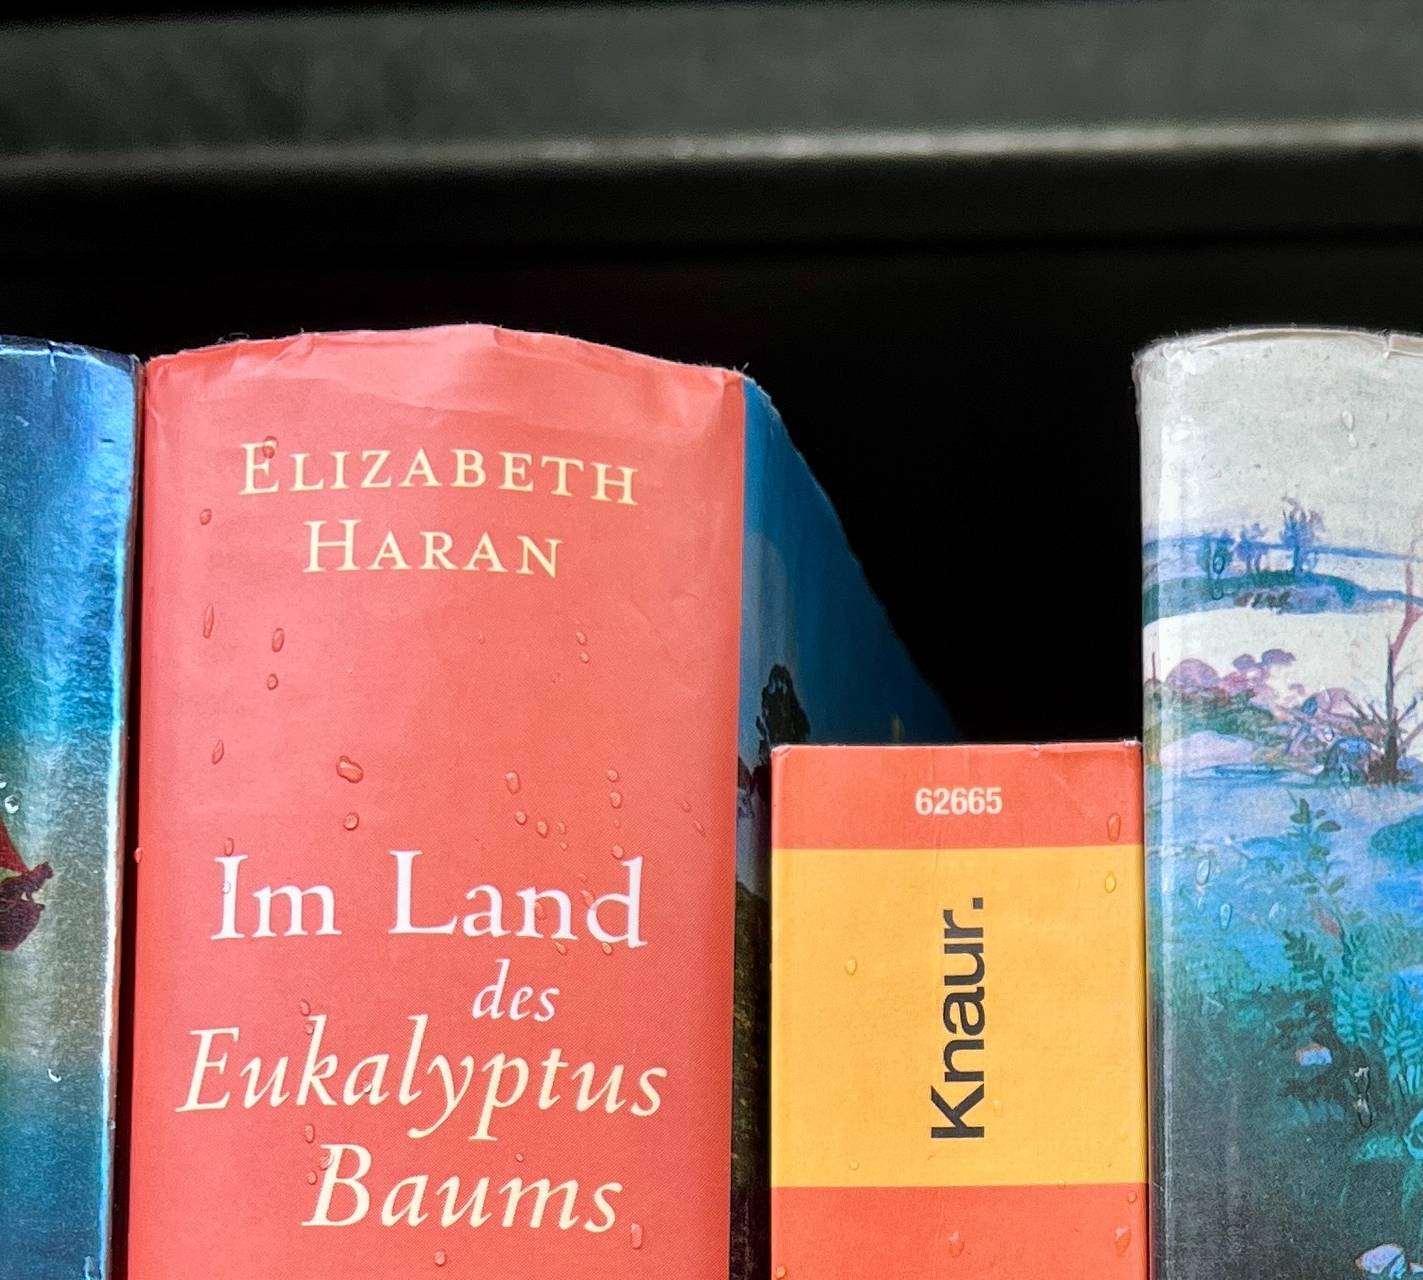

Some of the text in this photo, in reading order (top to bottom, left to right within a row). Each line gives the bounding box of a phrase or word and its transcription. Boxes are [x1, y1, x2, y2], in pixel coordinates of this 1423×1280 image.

[239, 440, 640, 506] ELIZABETH
[302, 519, 564, 579] HARAN
[914, 786, 1003, 815] 62665
[209, 850, 649, 948] Im Land
[472, 959, 559, 1022] des
[930, 897, 985, 1139] Knaur.
[175, 1014, 667, 1141] Eukalyptus
[301, 1143, 623, 1233] Baums
